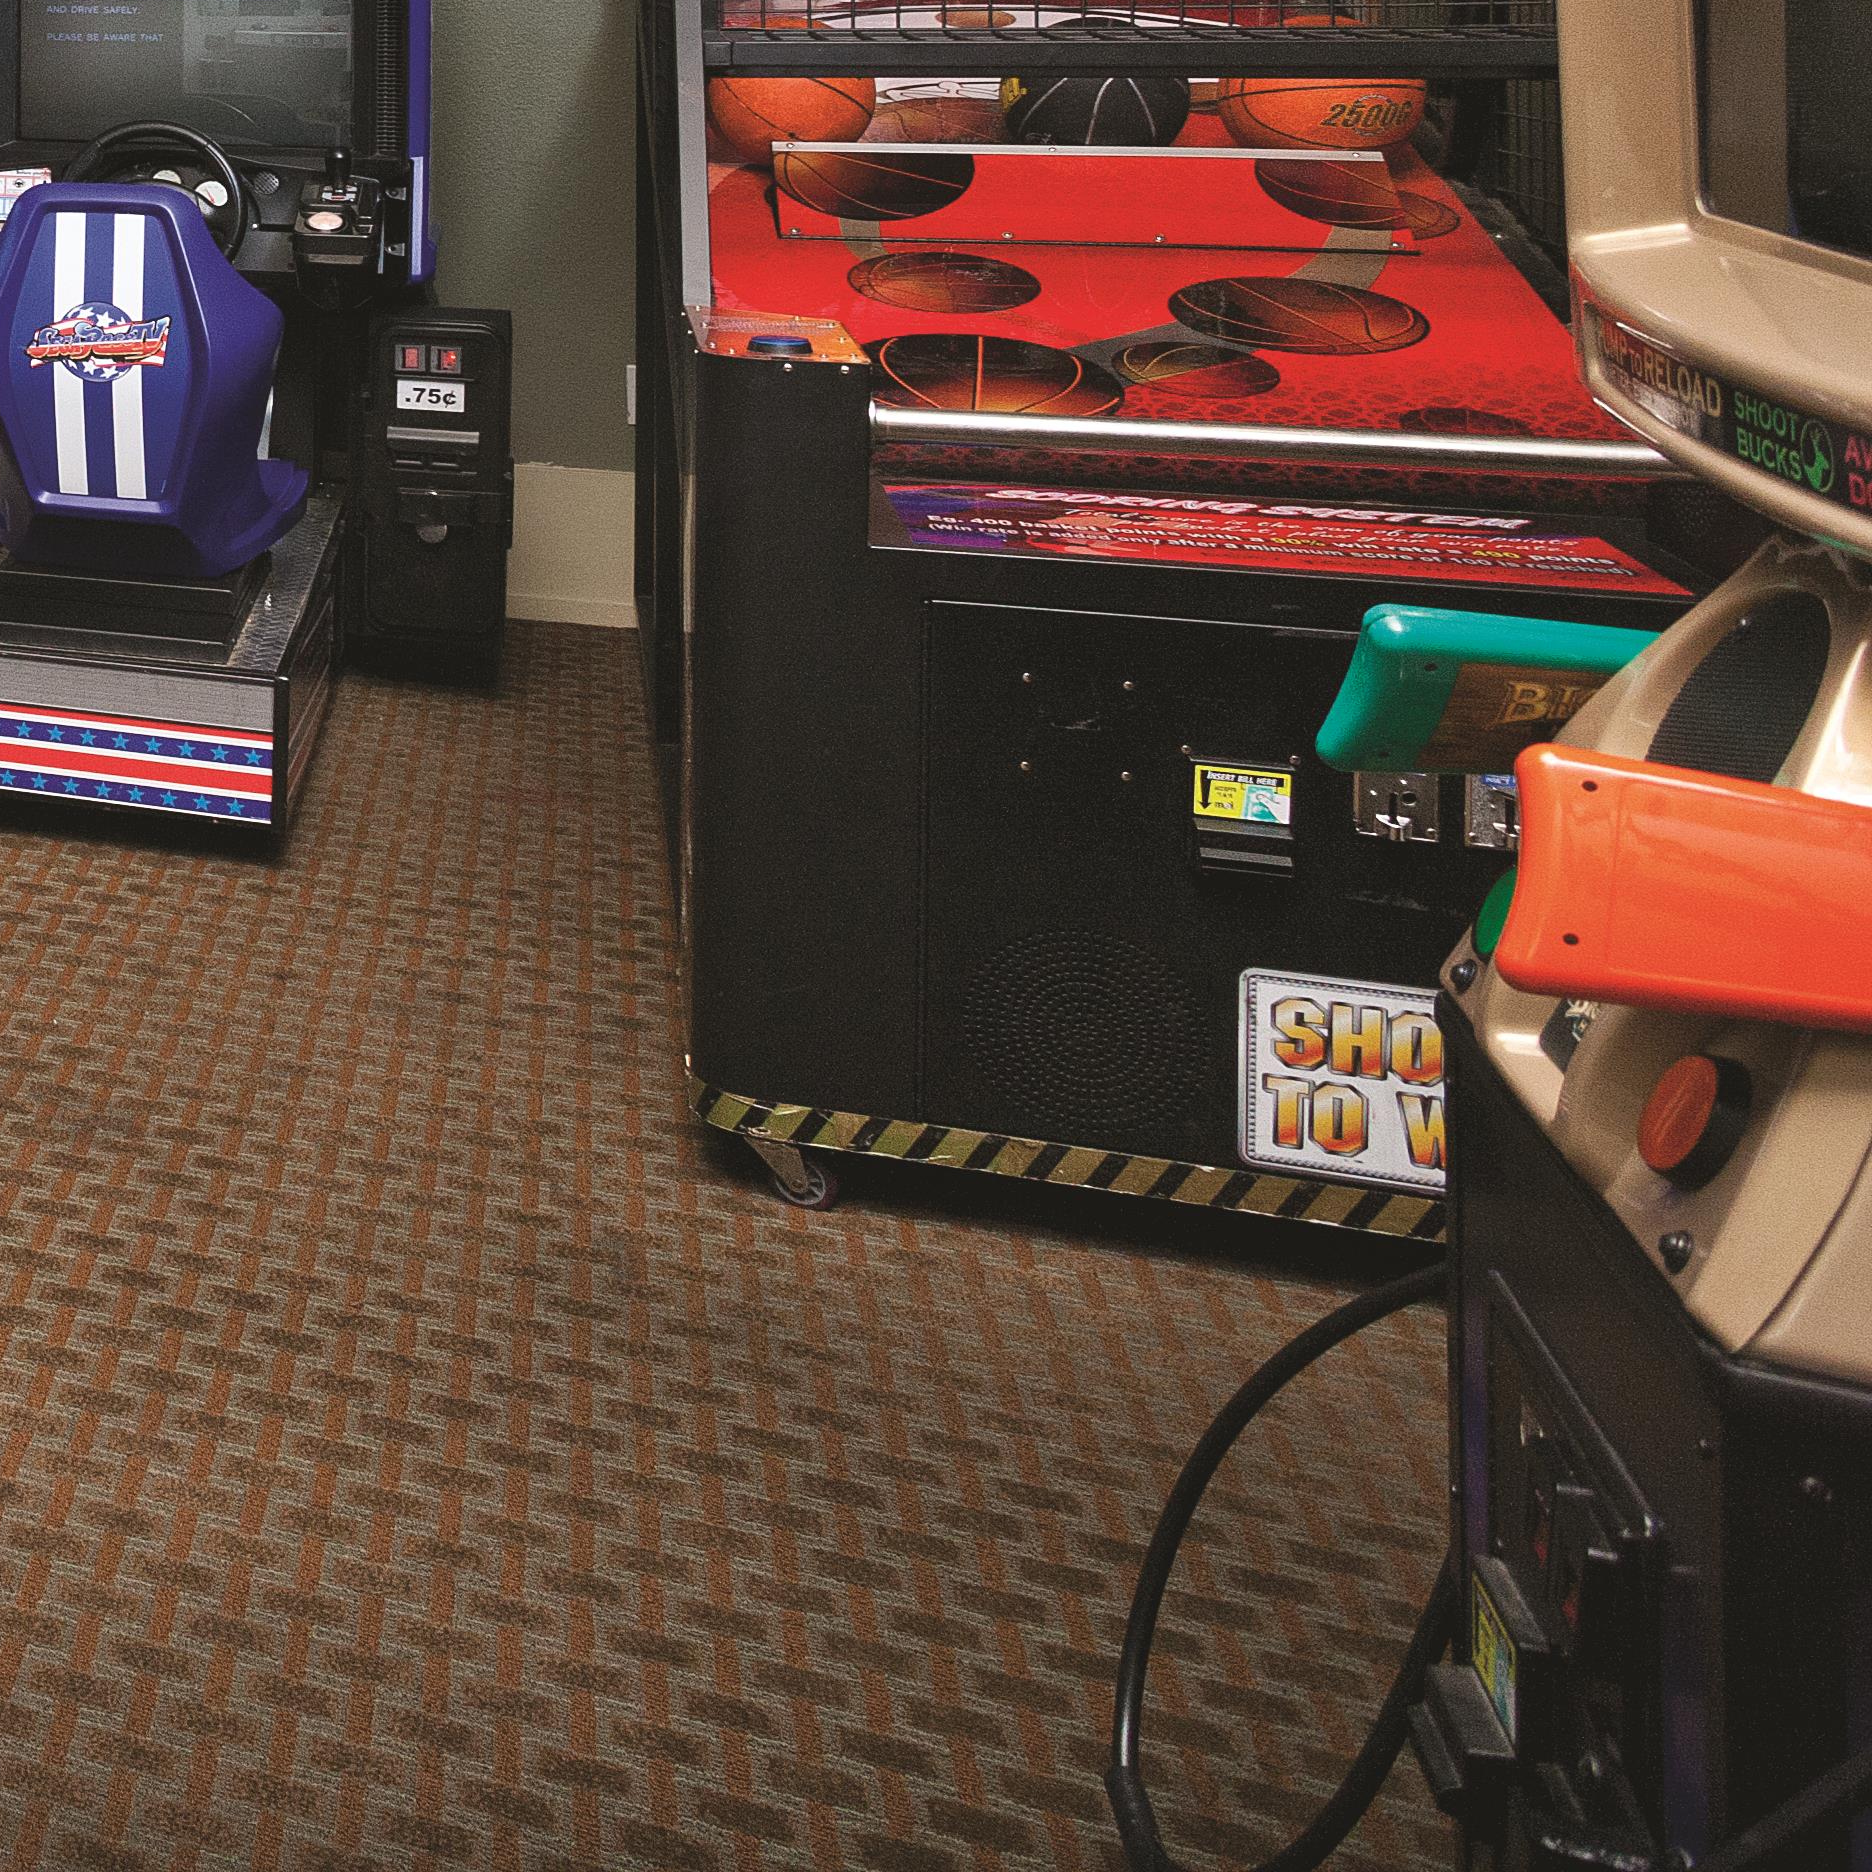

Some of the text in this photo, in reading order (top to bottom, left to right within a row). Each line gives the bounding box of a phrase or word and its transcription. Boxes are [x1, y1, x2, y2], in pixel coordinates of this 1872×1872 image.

[46, 5, 99, 14] AND DRIVE
[46, 32, 82, 42] PLEASE
[104, 33, 136, 42] AWARE
[140, 33, 163, 42] THAT
[1642, 345, 1723, 417] RELOAD
[1734, 391, 1799, 442] SHOOT
[1736, 426, 1802, 481] BUCKS
[927, 514, 964, 525] Eg.
[969, 516, 1013, 526] 400
[1019, 519, 1098, 533] basket
[1106, 524, 1181, 538] points
[1187, 532, 1241, 542] with
[1270, 537, 1327, 547] 90%
[1333, 542, 1379, 550] win
[1386, 545, 1440, 554] rate
[1471, 549, 1521, 559] 490
[1528, 554, 1616, 565] points
[1258, 504, 1533, 528] SYSTEM
[979, 527, 1016, 535] rate
[1049, 531, 1121, 541] added
[1123, 535, 1161, 545] only
[1167, 538, 1219, 547] after
[1242, 543, 1342, 557] minimum
[1347, 552, 1414, 561] score
[1420, 555, 1442, 563] of
[1450, 557, 1492, 566] 100
[1498, 559, 1521, 567] is
[1526, 563, 1634, 576] reached)
[1207, 771, 1279, 787] INSERT BILL HERE
[1270, 996, 1444, 1087] SHO
[1262, 1072, 1370, 1158] TO
